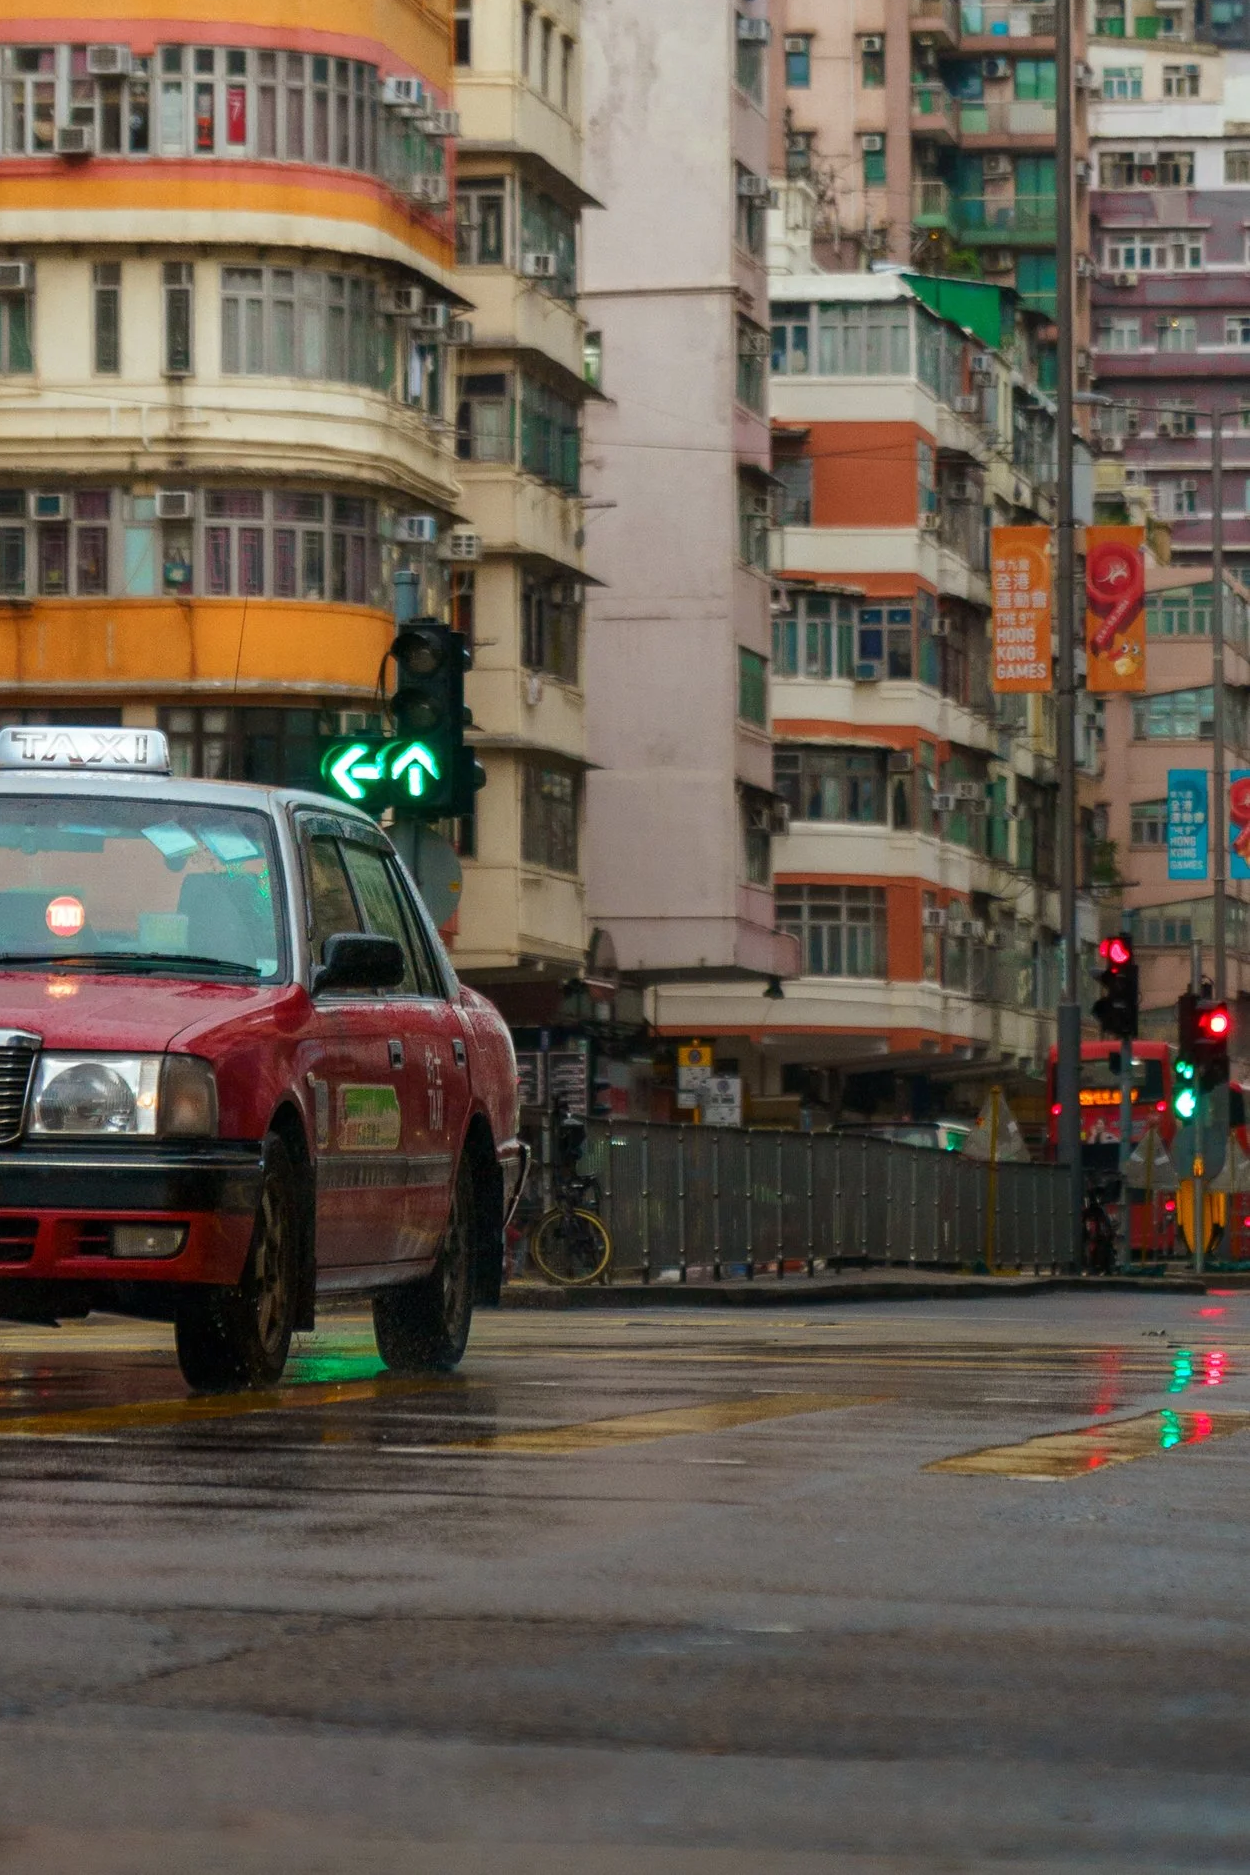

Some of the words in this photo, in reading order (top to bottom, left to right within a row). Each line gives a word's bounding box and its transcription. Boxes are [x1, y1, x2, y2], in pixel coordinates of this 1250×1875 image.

[996, 573, 1030, 590] 全港
[996, 612, 1016, 625] THE
[996, 627, 1036, 643] HONG
[996, 645, 1037, 661] KONG
[996, 663, 1047, 679] GAMES
[10, 731, 149, 765] TAXI
[49, 906, 81, 927] TAXI
[428, 1088, 443, 1131] TAXI
